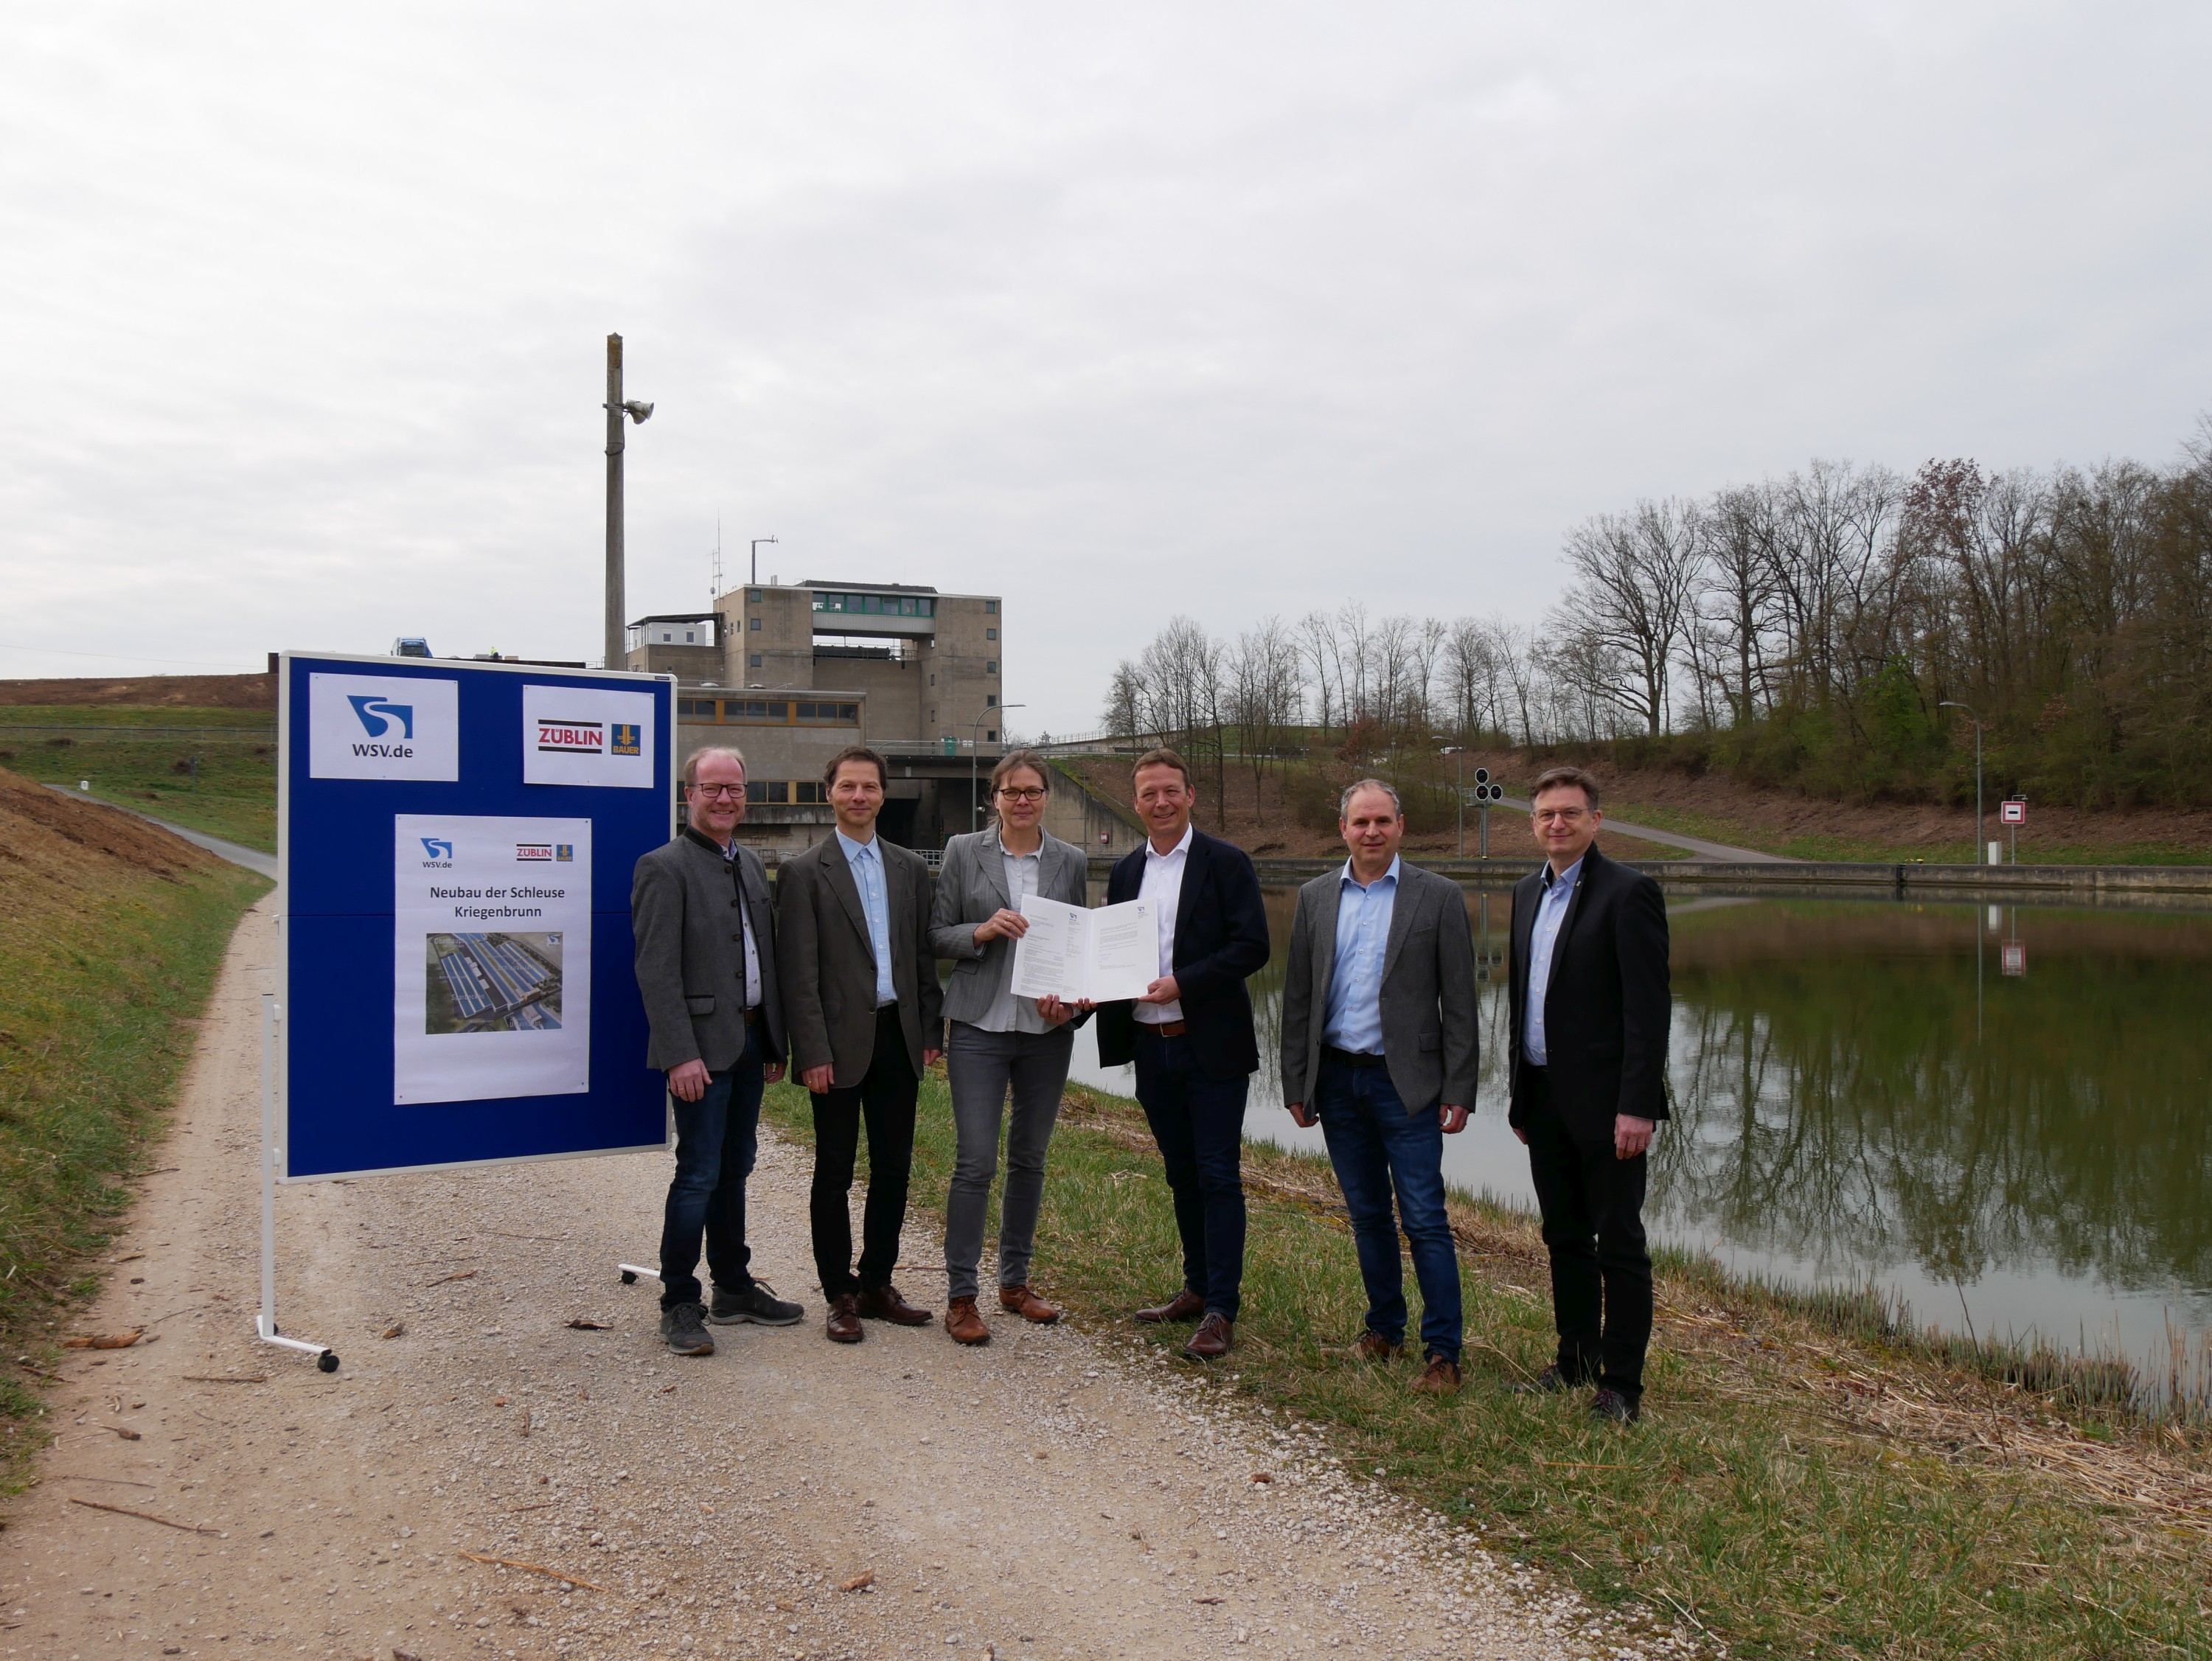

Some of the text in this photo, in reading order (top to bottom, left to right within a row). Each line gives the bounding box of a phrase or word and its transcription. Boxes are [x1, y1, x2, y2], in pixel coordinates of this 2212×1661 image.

[538, 728, 602, 745] ZÜBLIN
[352, 744, 414, 758] WSV.de
[613, 745, 639, 754] BAUER
[517, 848, 552, 857] ZÜBLIN
[430, 886, 565, 898] Neubau der Schleuse
[455, 905, 541, 919] Kriegenbrunn
